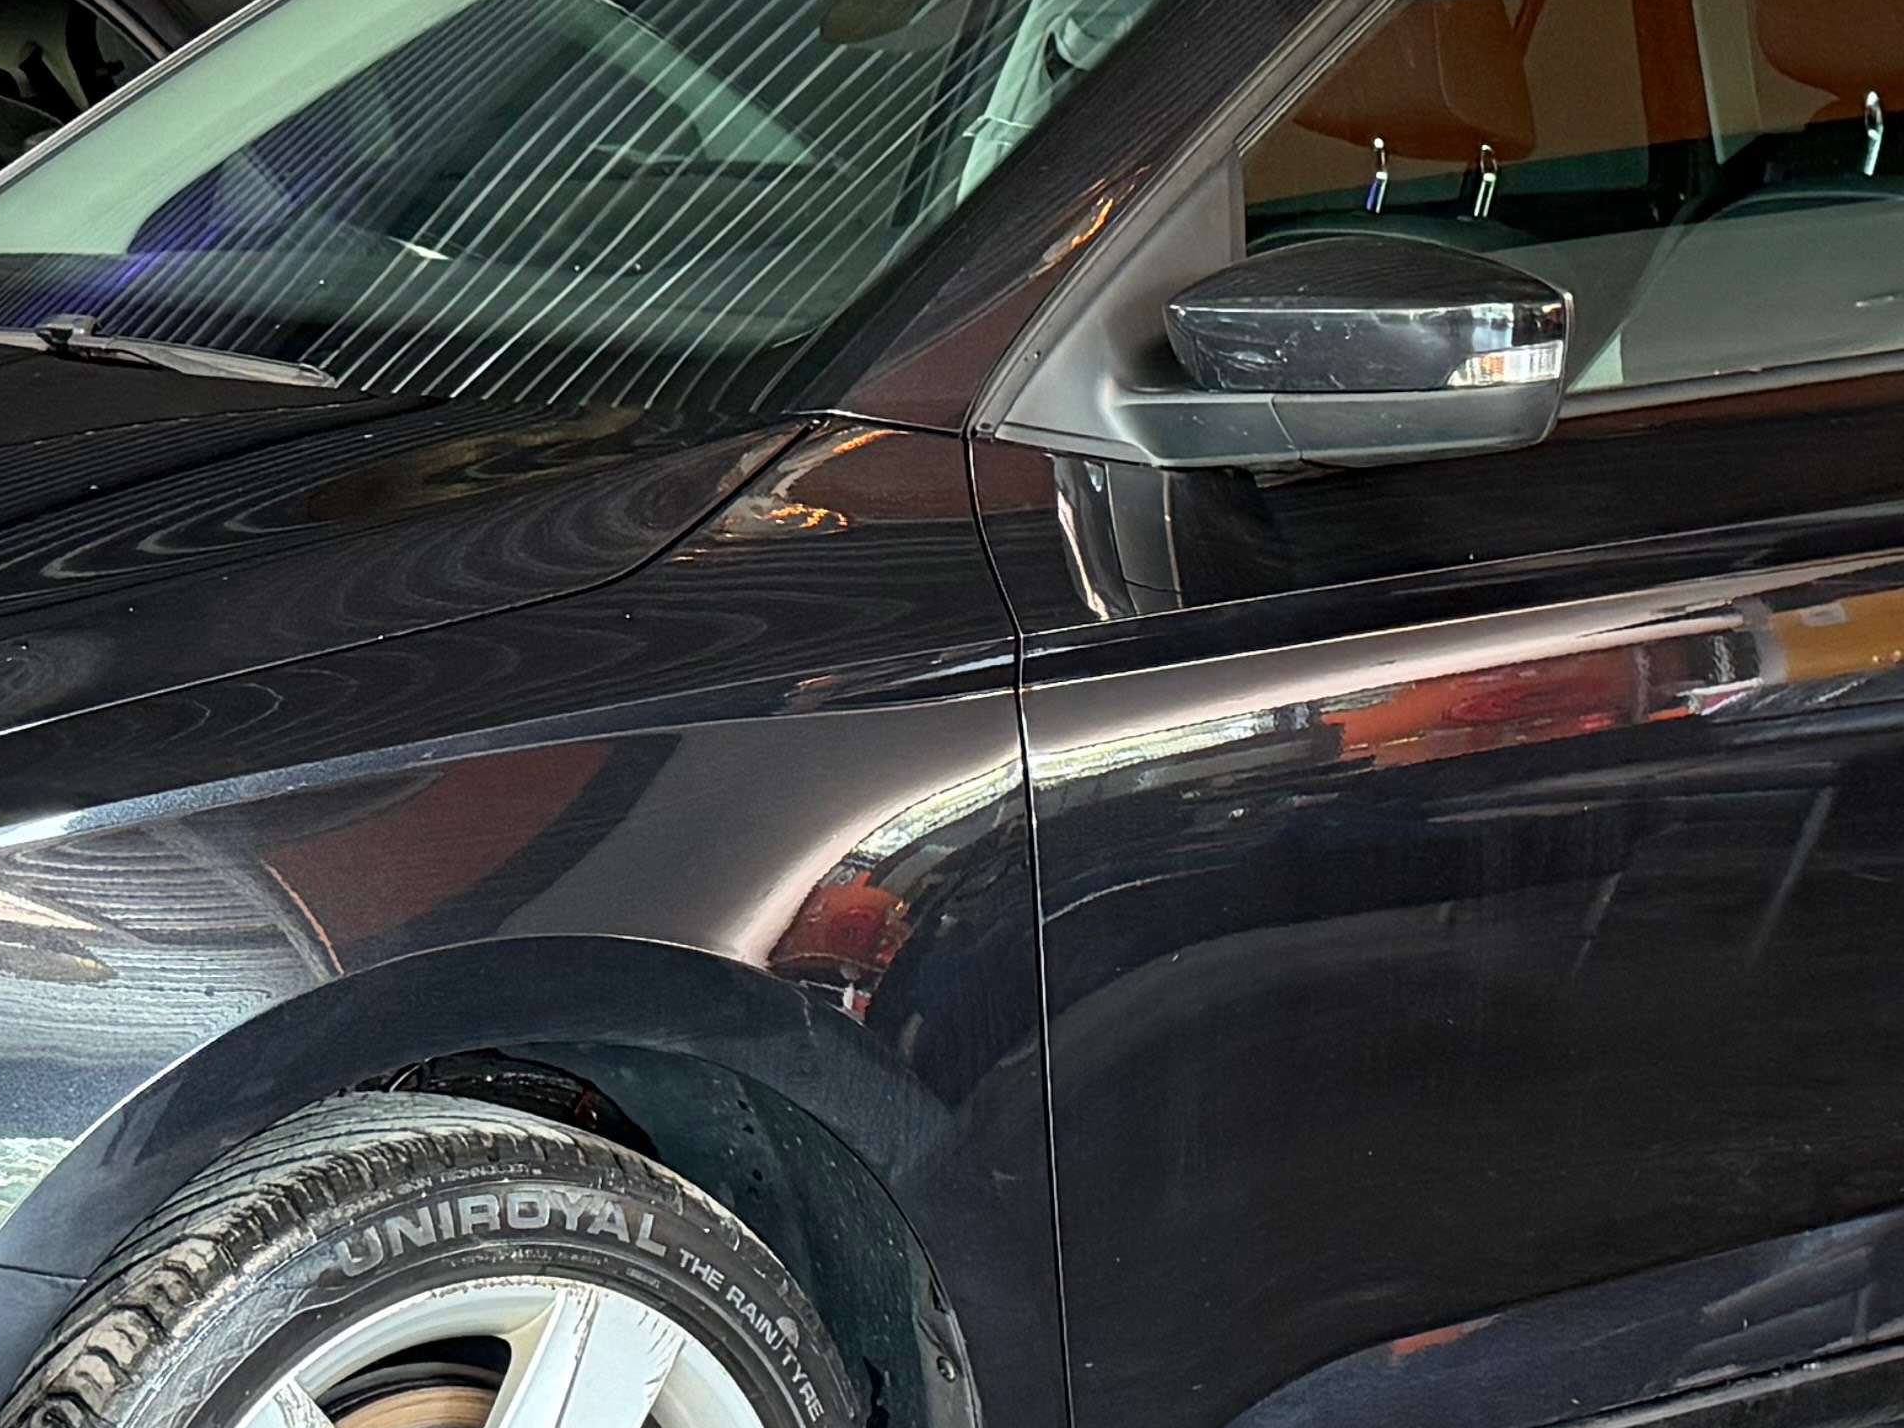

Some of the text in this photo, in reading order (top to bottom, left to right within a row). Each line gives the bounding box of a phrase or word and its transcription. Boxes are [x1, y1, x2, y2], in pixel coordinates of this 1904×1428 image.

[337, 1189, 667, 1277] UNIROYAL
[679, 1248, 725, 1291] THE
[725, 1284, 778, 1346] RAIN
[782, 1345, 825, 1422] TYRE
